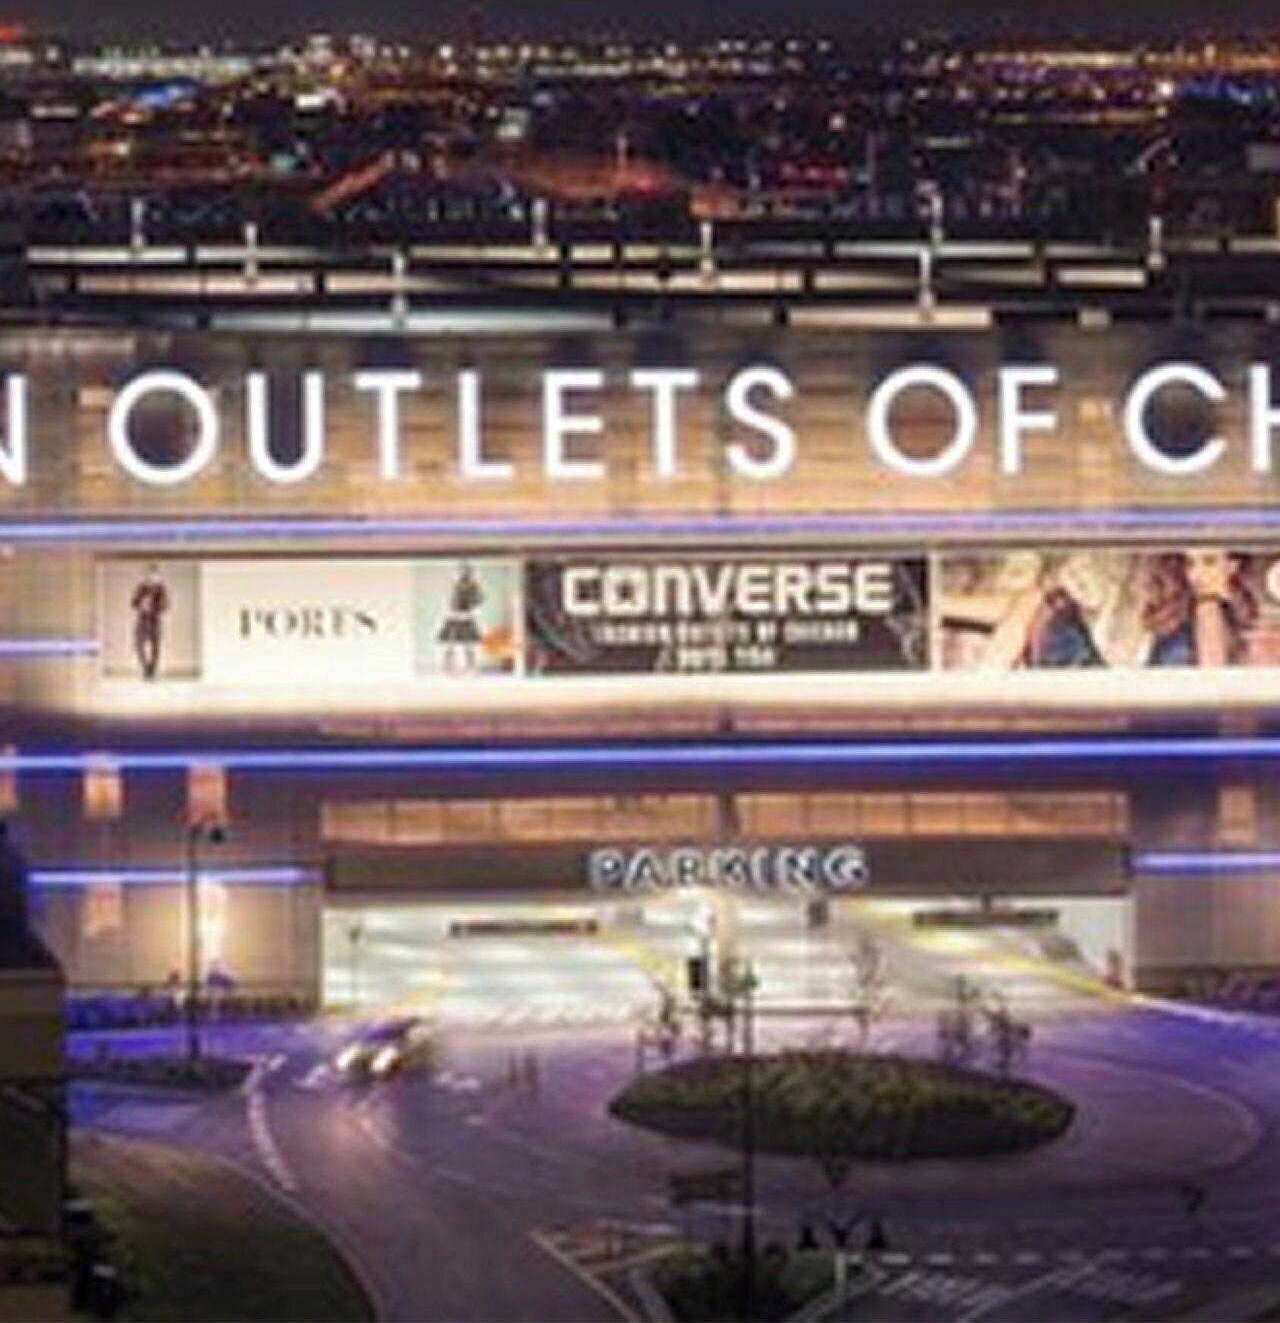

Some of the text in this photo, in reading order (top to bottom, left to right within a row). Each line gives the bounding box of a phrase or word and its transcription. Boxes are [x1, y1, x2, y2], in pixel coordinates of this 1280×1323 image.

[108, 367, 795, 484] OUTLETS
[867, 365, 1059, 480] OF
[562, 563, 893, 617] CONVERSE
[238, 606, 380, 640] PORTS
[588, 846, 871, 891] PARKING
